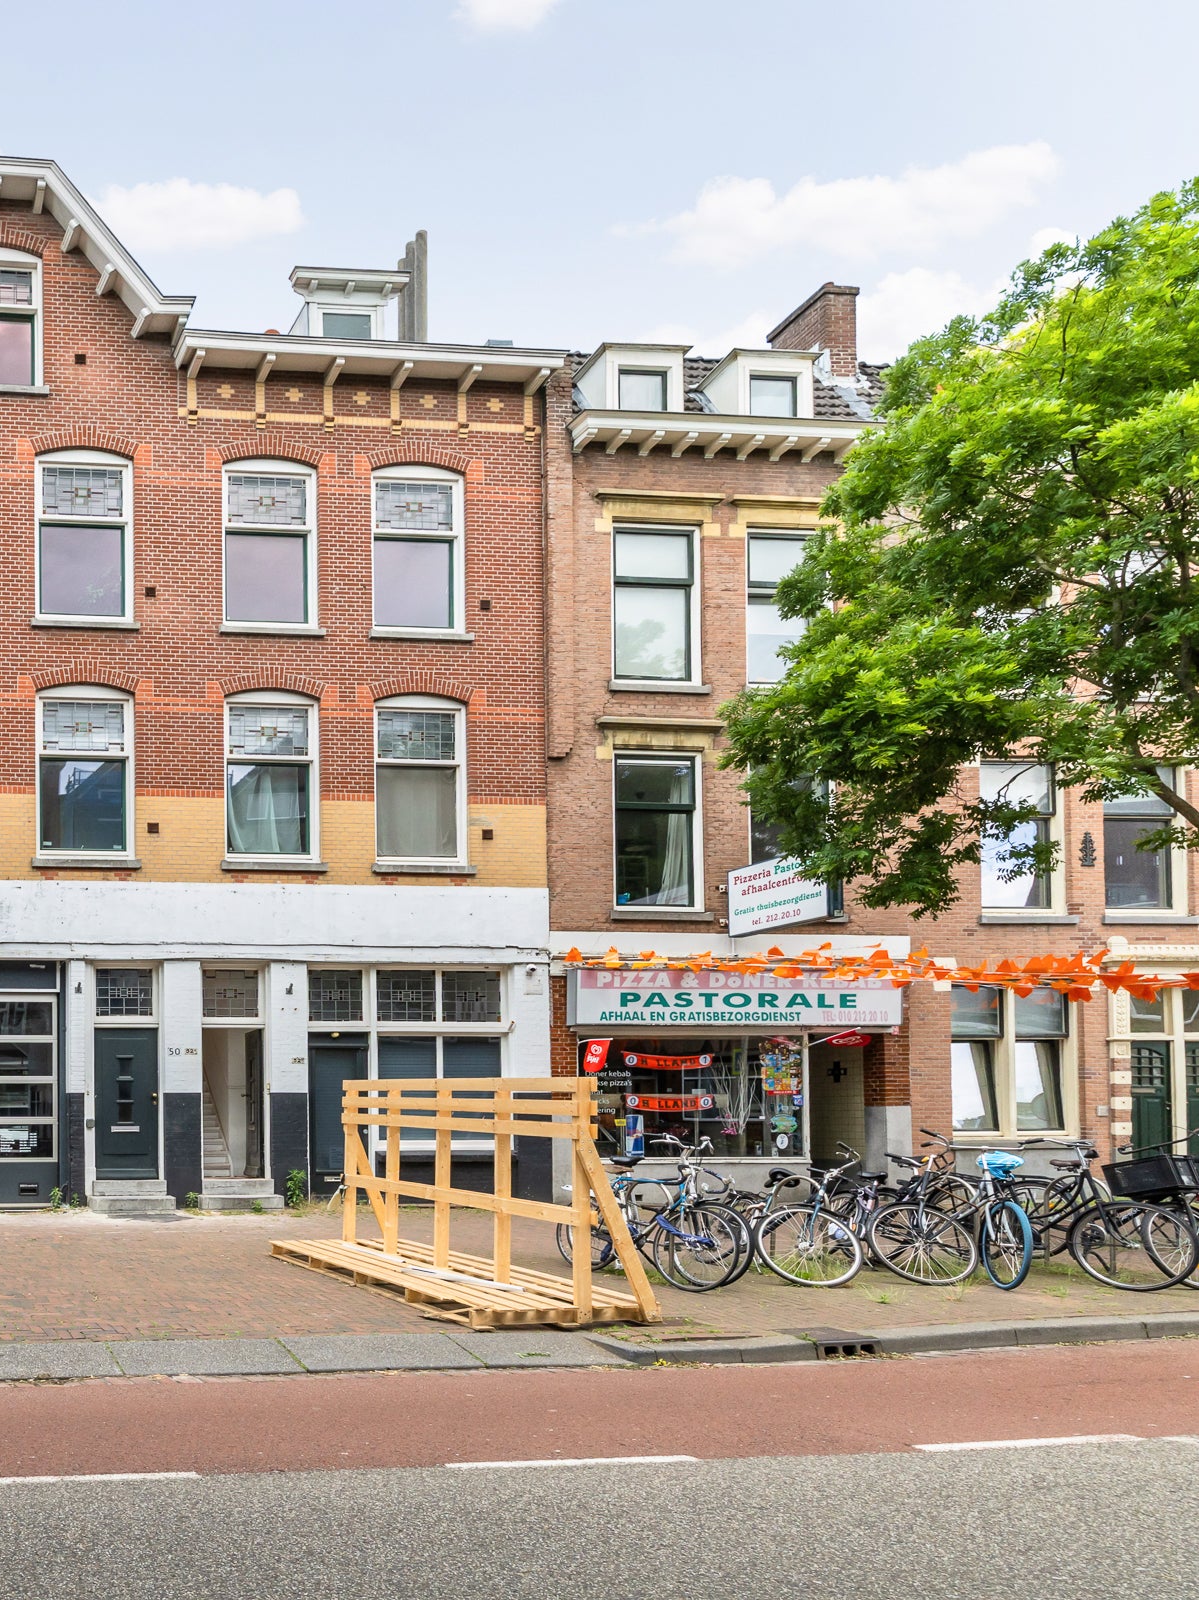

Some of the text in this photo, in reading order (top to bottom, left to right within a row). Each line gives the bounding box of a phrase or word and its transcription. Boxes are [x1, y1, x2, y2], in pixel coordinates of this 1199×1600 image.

[733, 869, 771, 886] Pizzeria
[741, 875, 806, 896] afhaalcentru
[734, 890, 822, 916] Gratis thuisbezorgdienst
[751, 908, 801, 926] tel. 212.20.10
[680, 971, 700, 988] &
[620, 992, 857, 1008] PASTORALE
[599, 1011, 646, 1022] AFHAAL
[650, 1011, 665, 1022] EN
[669, 1011, 801, 1022] GRATISBEZORGDIENST
[838, 1010, 852, 1022] 010
[852, 1010, 867, 1022] 212
[868, 1010, 878, 1022] 20
[880, 1010, 889, 1022] 10
[168, 1047, 181, 1056] 50
